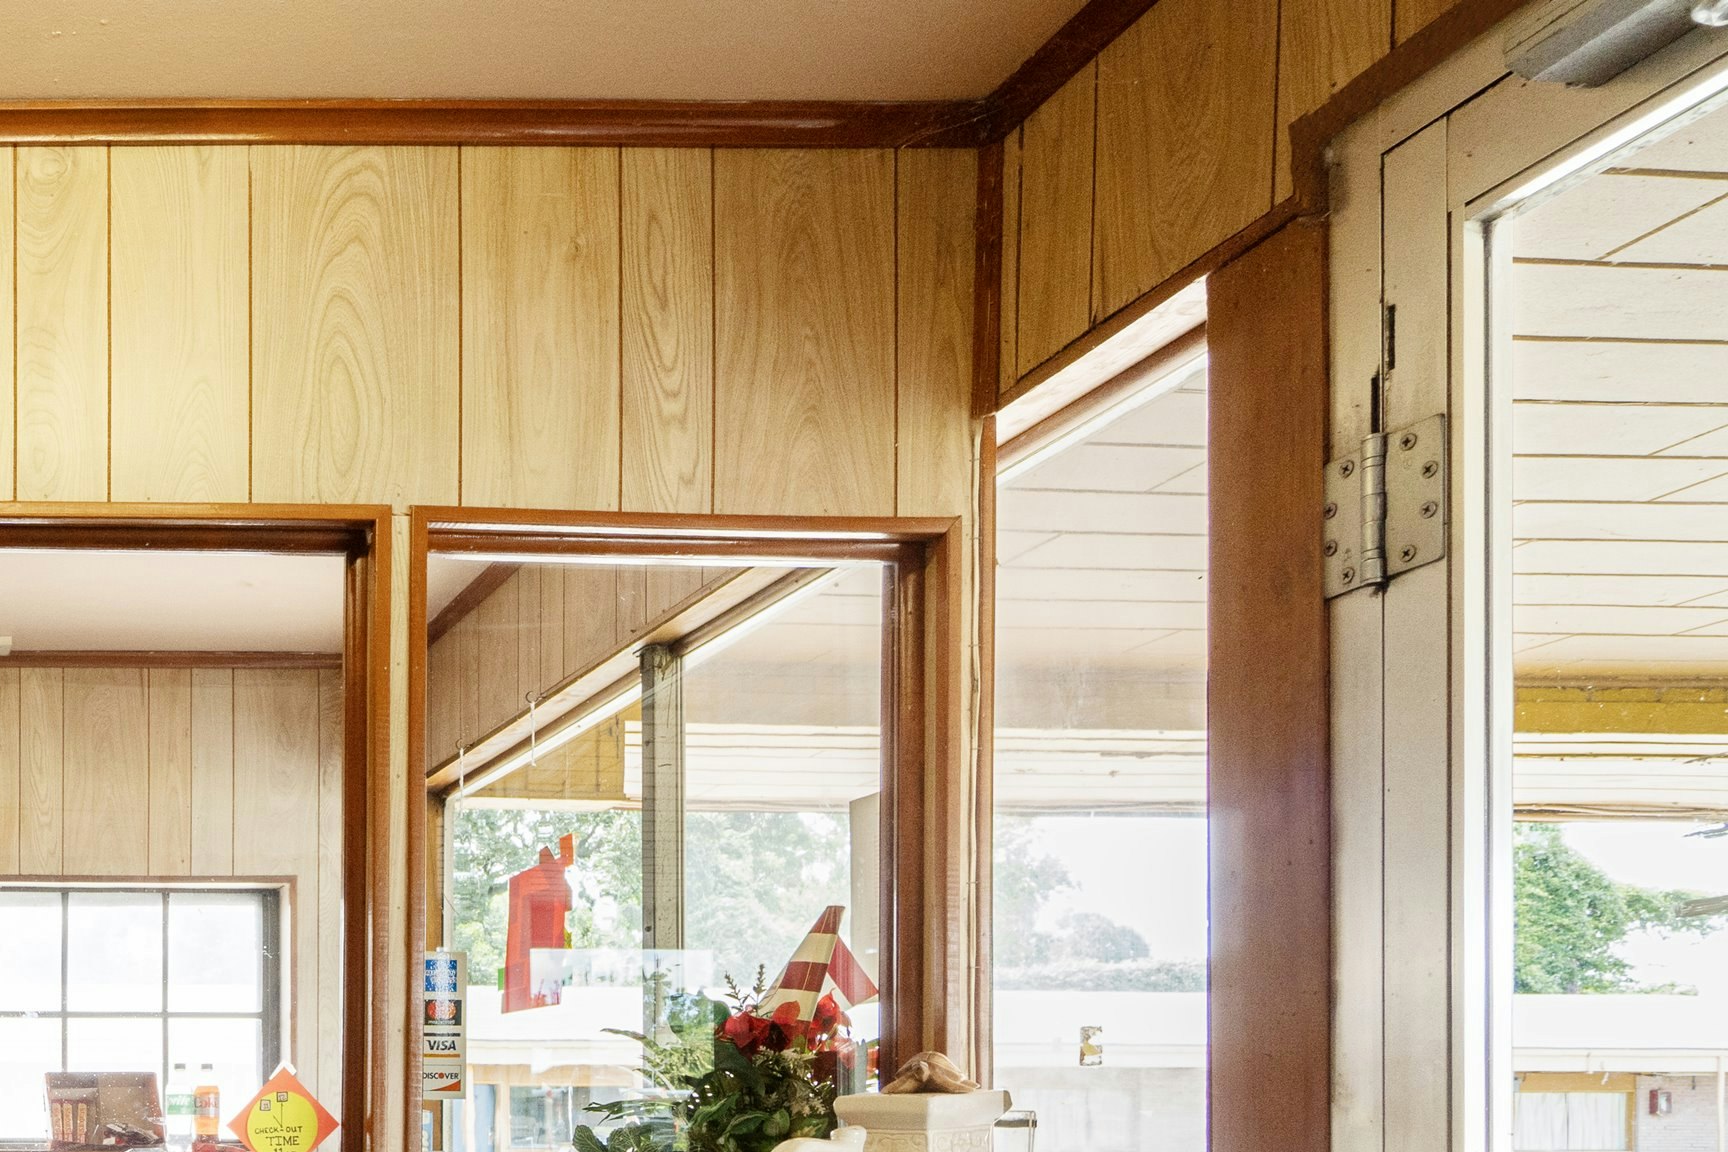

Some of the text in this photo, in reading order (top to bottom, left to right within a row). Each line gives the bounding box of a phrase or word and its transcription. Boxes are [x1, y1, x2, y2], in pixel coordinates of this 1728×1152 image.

[427, 1040, 456, 1051] VISA
[423, 1072, 459, 1080] DISCOVER
[265, 1136, 300, 1146] TIME
